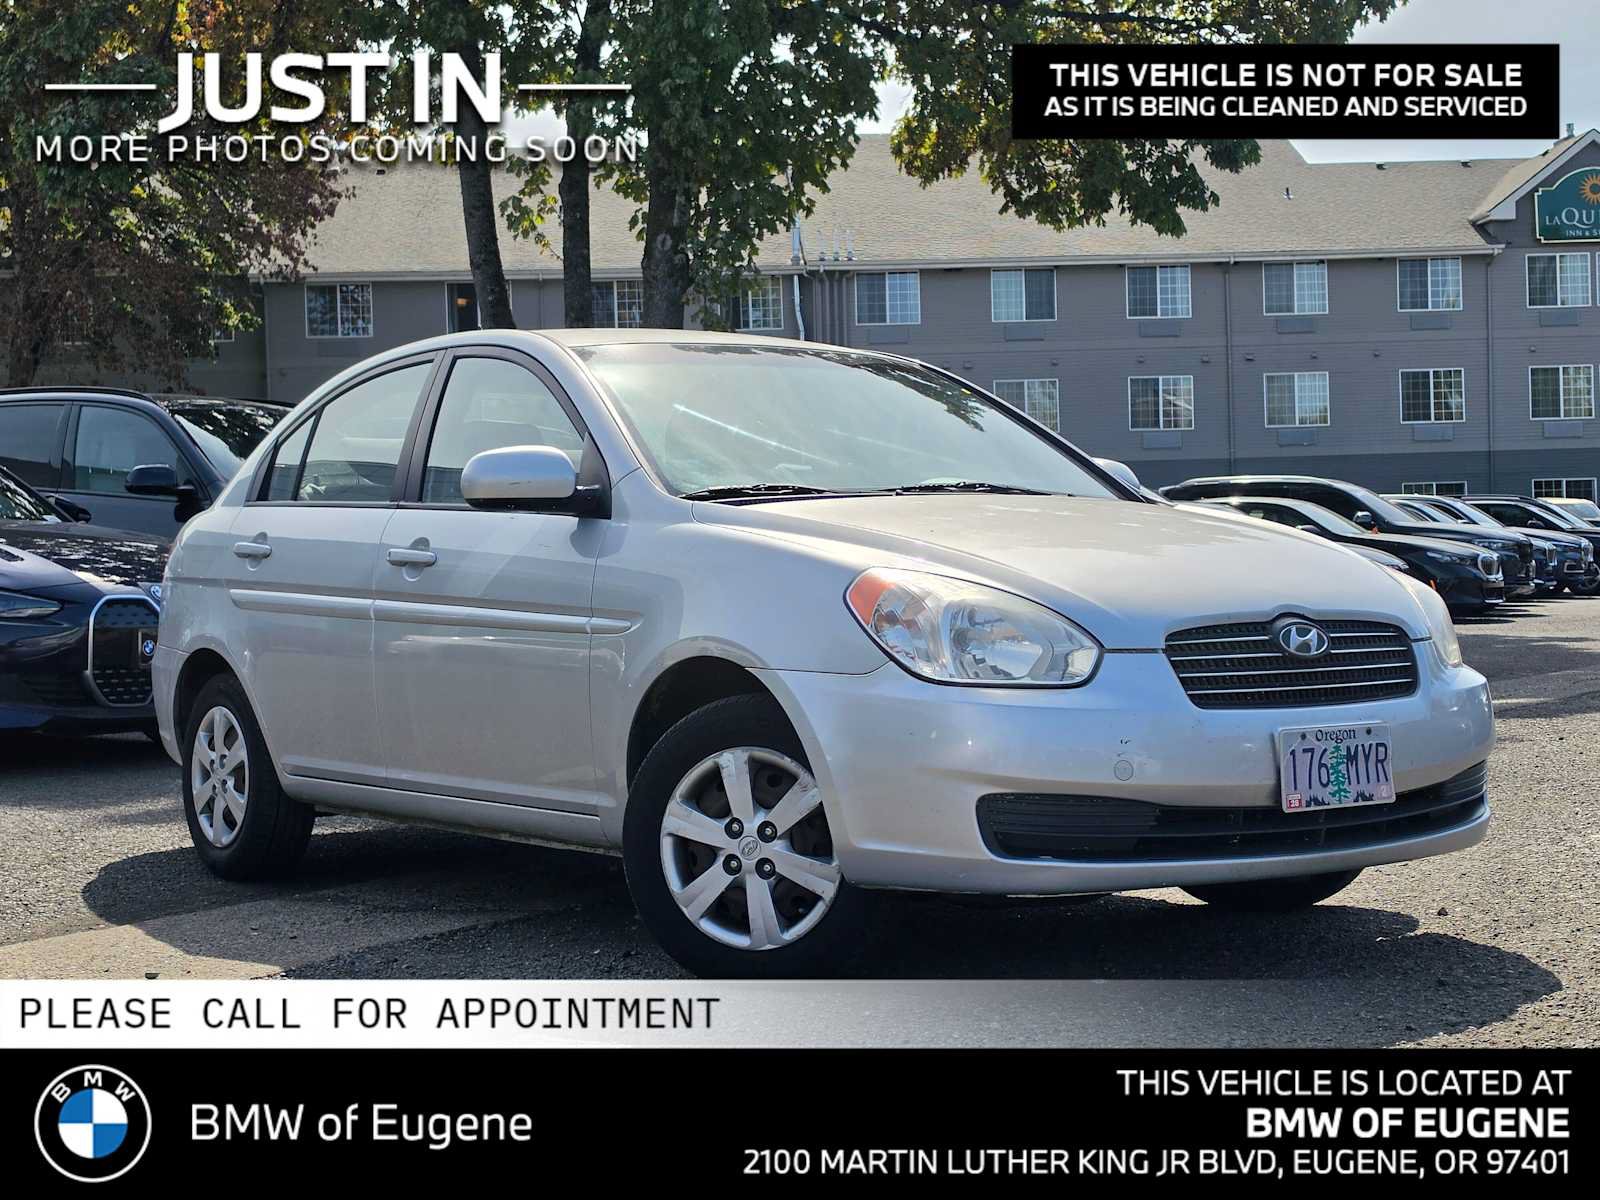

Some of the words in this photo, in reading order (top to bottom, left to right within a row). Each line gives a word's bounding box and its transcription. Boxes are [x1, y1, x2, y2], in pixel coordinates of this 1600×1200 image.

[1545, 215, 1560, 225] LA
[1561, 207, 1600, 229] QU
[1315, 729, 1357, 744] Oregon
[1290, 747, 1330, 791] 176
[1346, 742, 1389, 785] MYR
